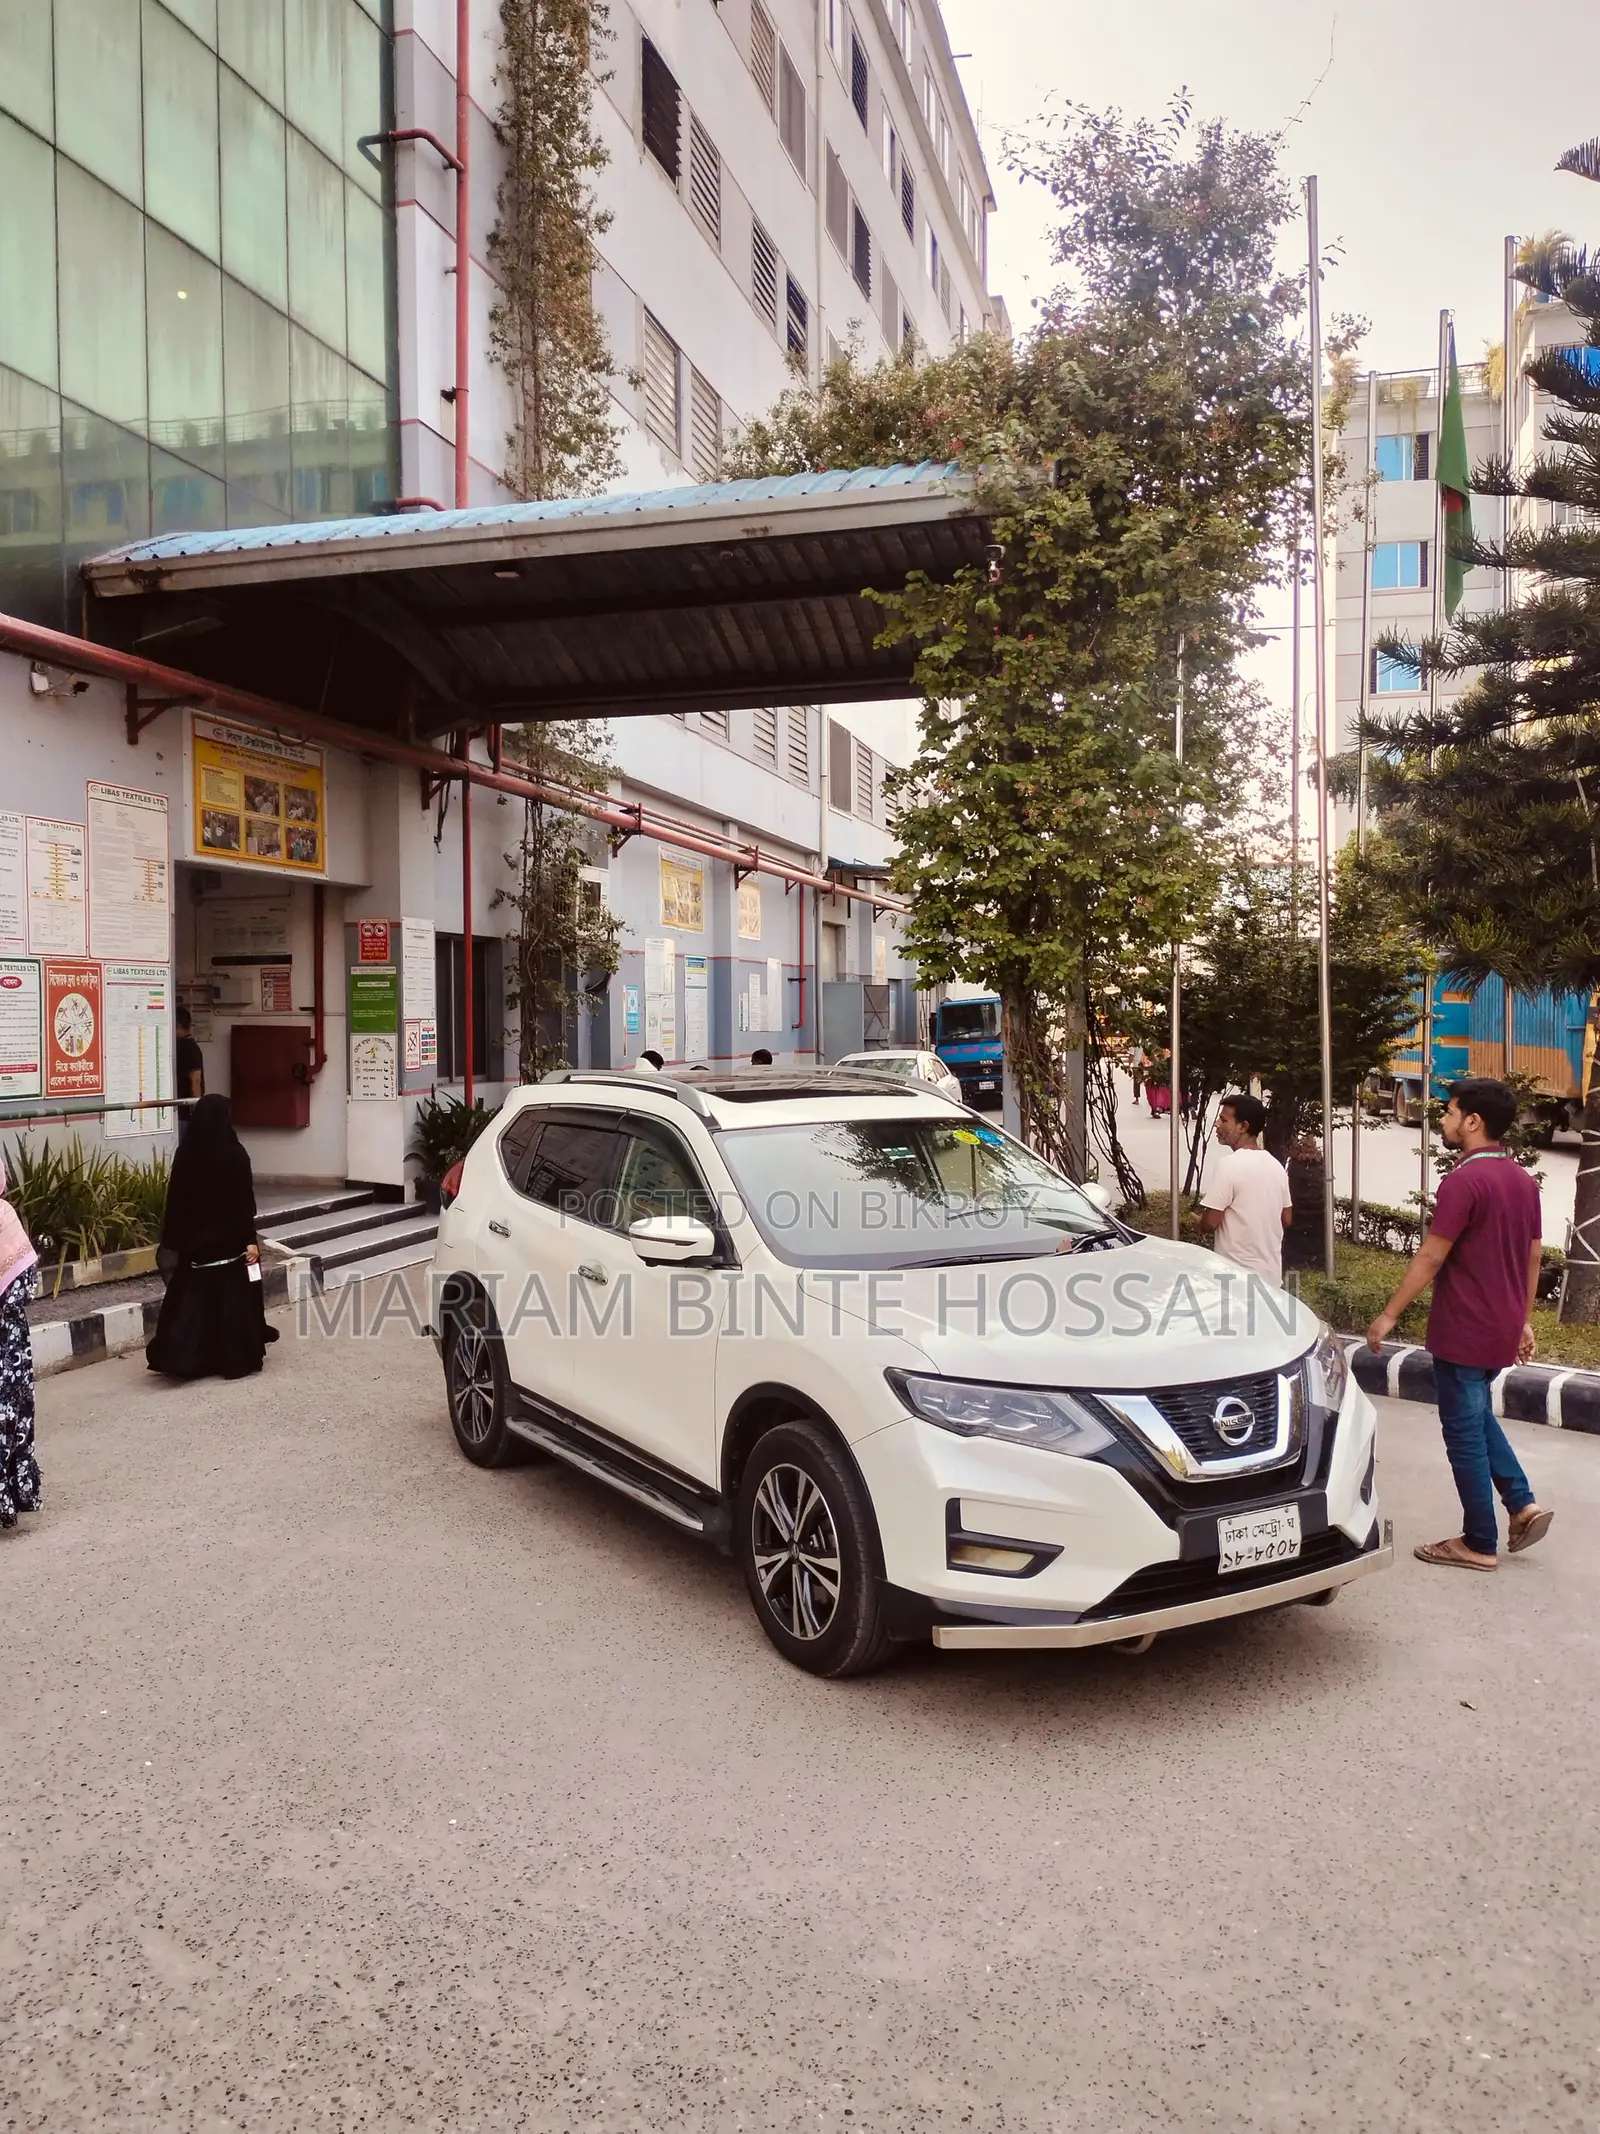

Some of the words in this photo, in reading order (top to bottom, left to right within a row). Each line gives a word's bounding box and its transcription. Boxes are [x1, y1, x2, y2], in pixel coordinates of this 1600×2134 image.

[101, 787, 120, 797] LIBAS
[122, 792, 152, 803] TEXTILES
[153, 797, 167, 807] LTD.
[51, 823, 72, 831] TEXTILES
[130, 968, 156, 976] TEXTILES
[1225, 1526, 1249, 1542] ঢাকা
[1222, 1539, 1299, 1569] ১৮-৮৫০৮
